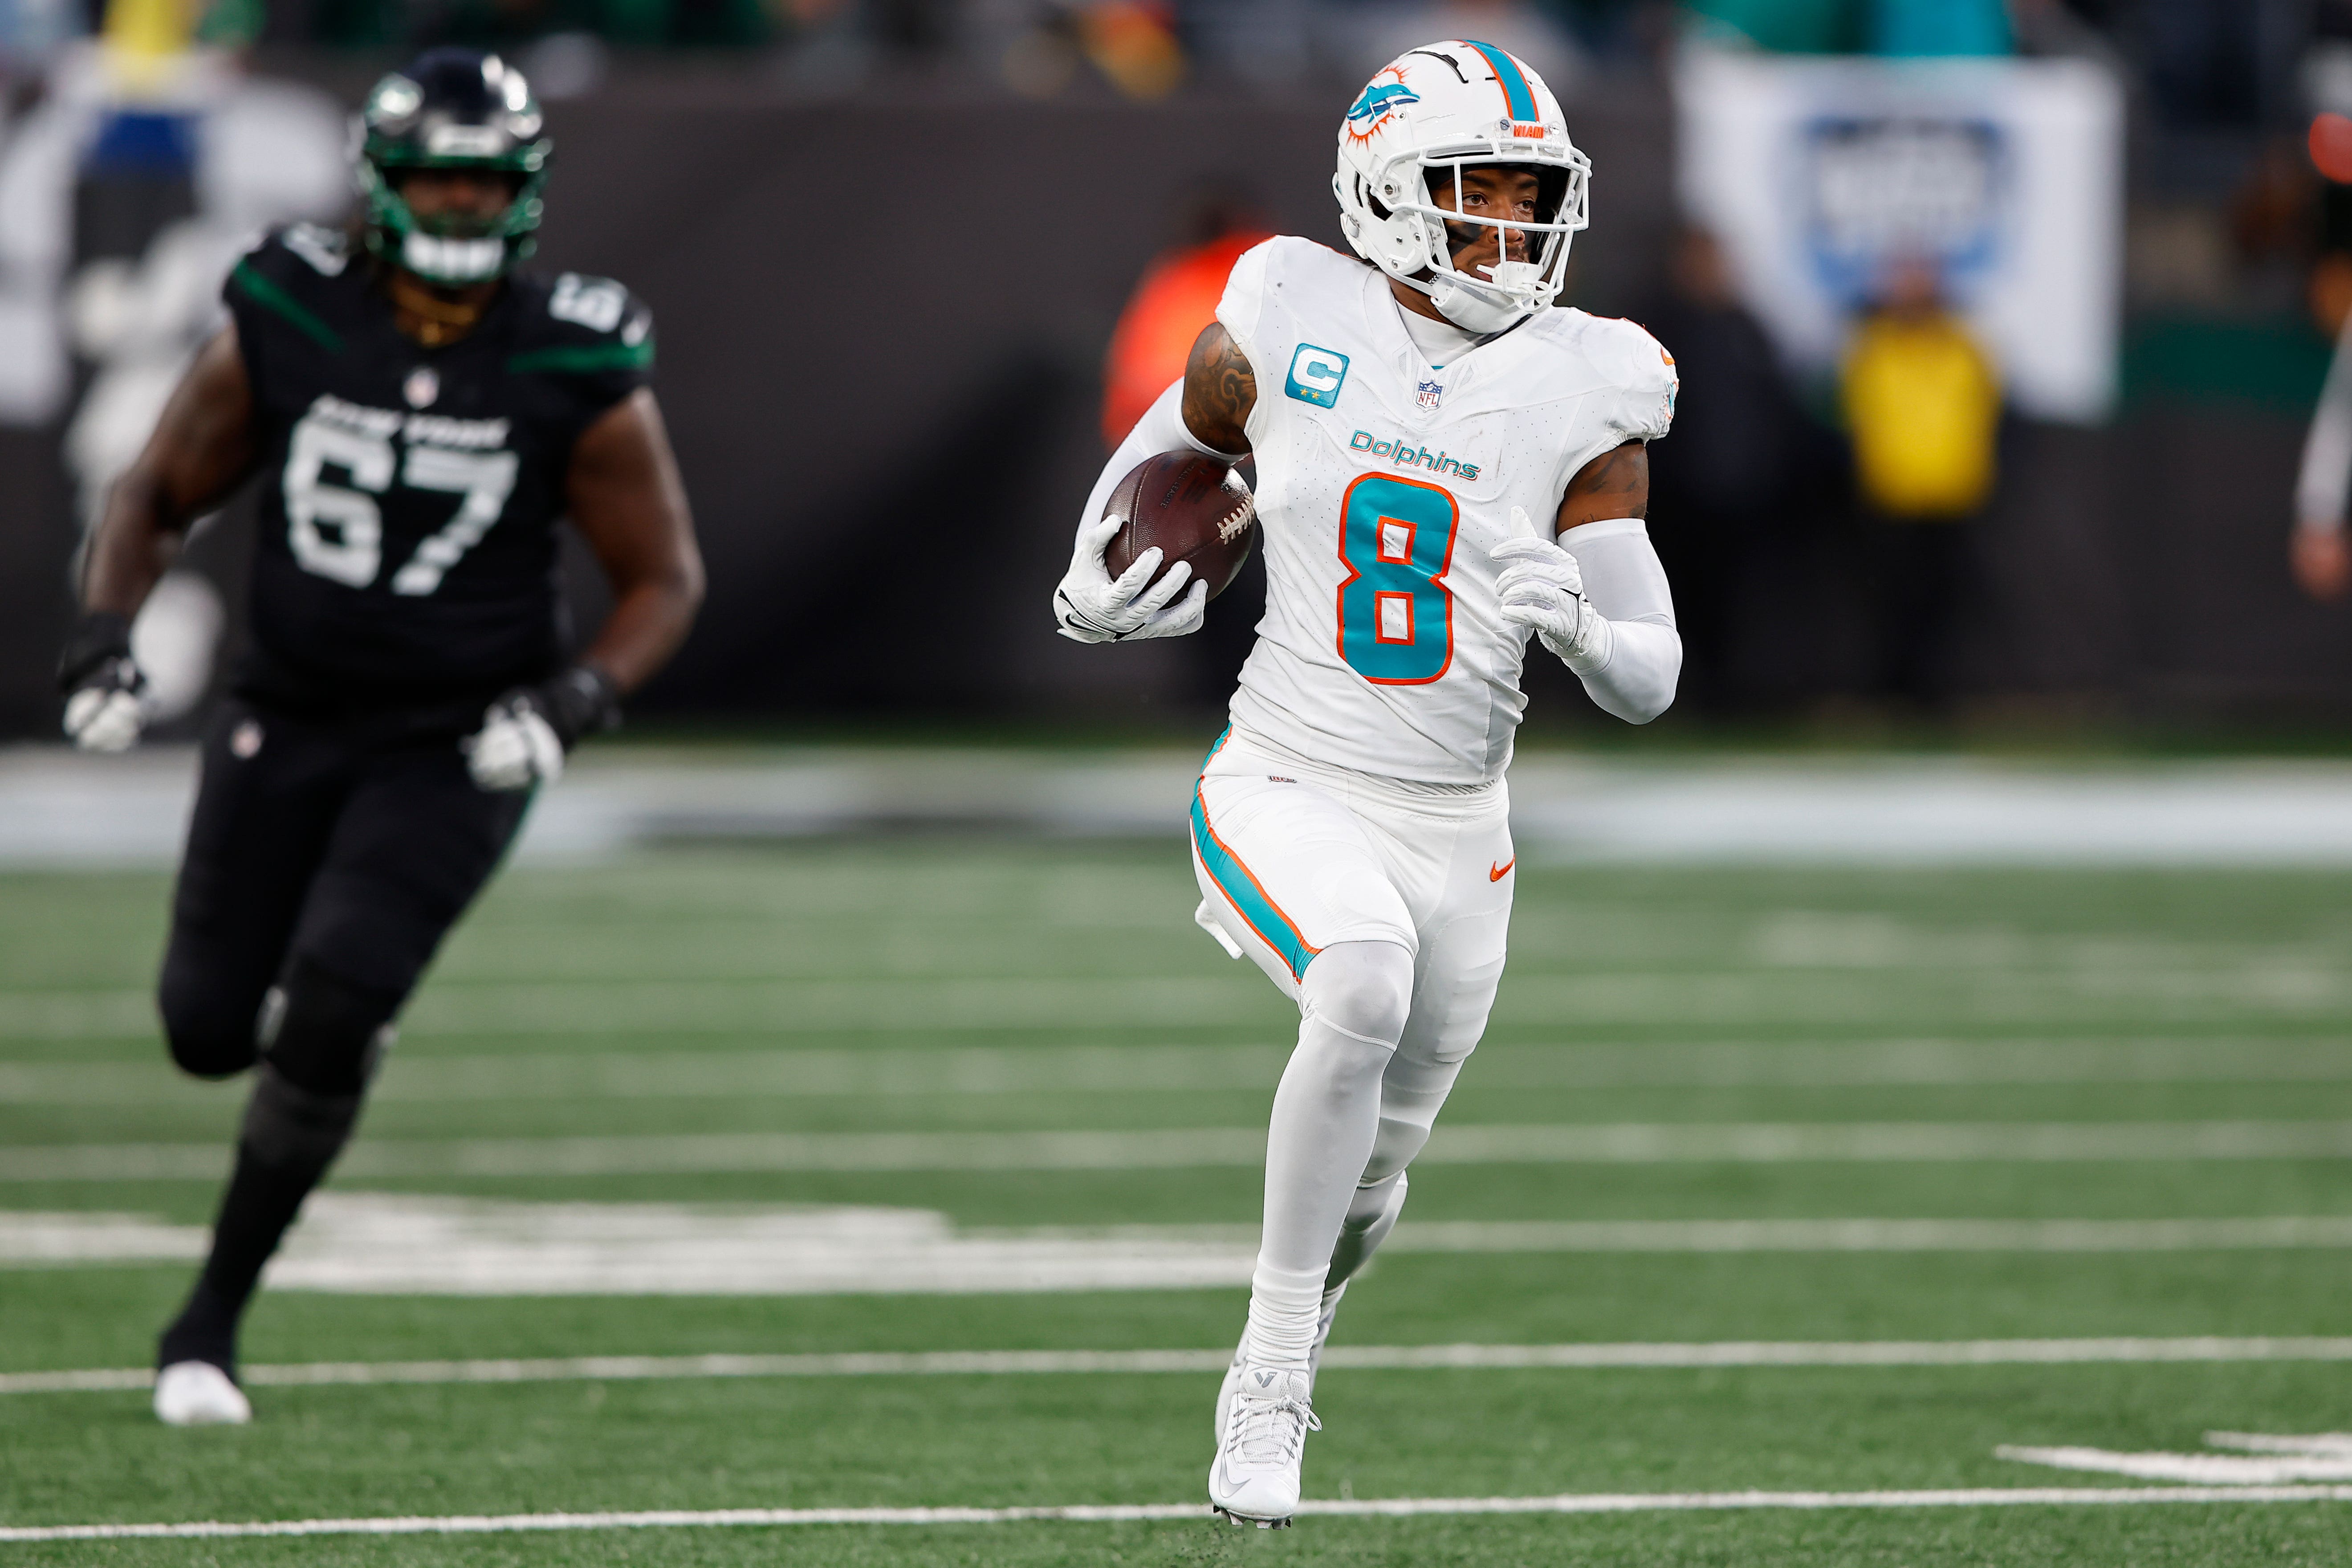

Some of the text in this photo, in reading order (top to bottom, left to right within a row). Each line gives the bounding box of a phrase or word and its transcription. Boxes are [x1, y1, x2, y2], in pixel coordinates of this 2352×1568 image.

[1514, 125, 1544, 139] MIAM
[1292, 348, 1343, 392] C
[1418, 392, 1437, 406] NFL
[1349, 429, 1481, 481] Dolphins
[282, 413, 520, 598] 67
[1337, 471, 1460, 685] 8
